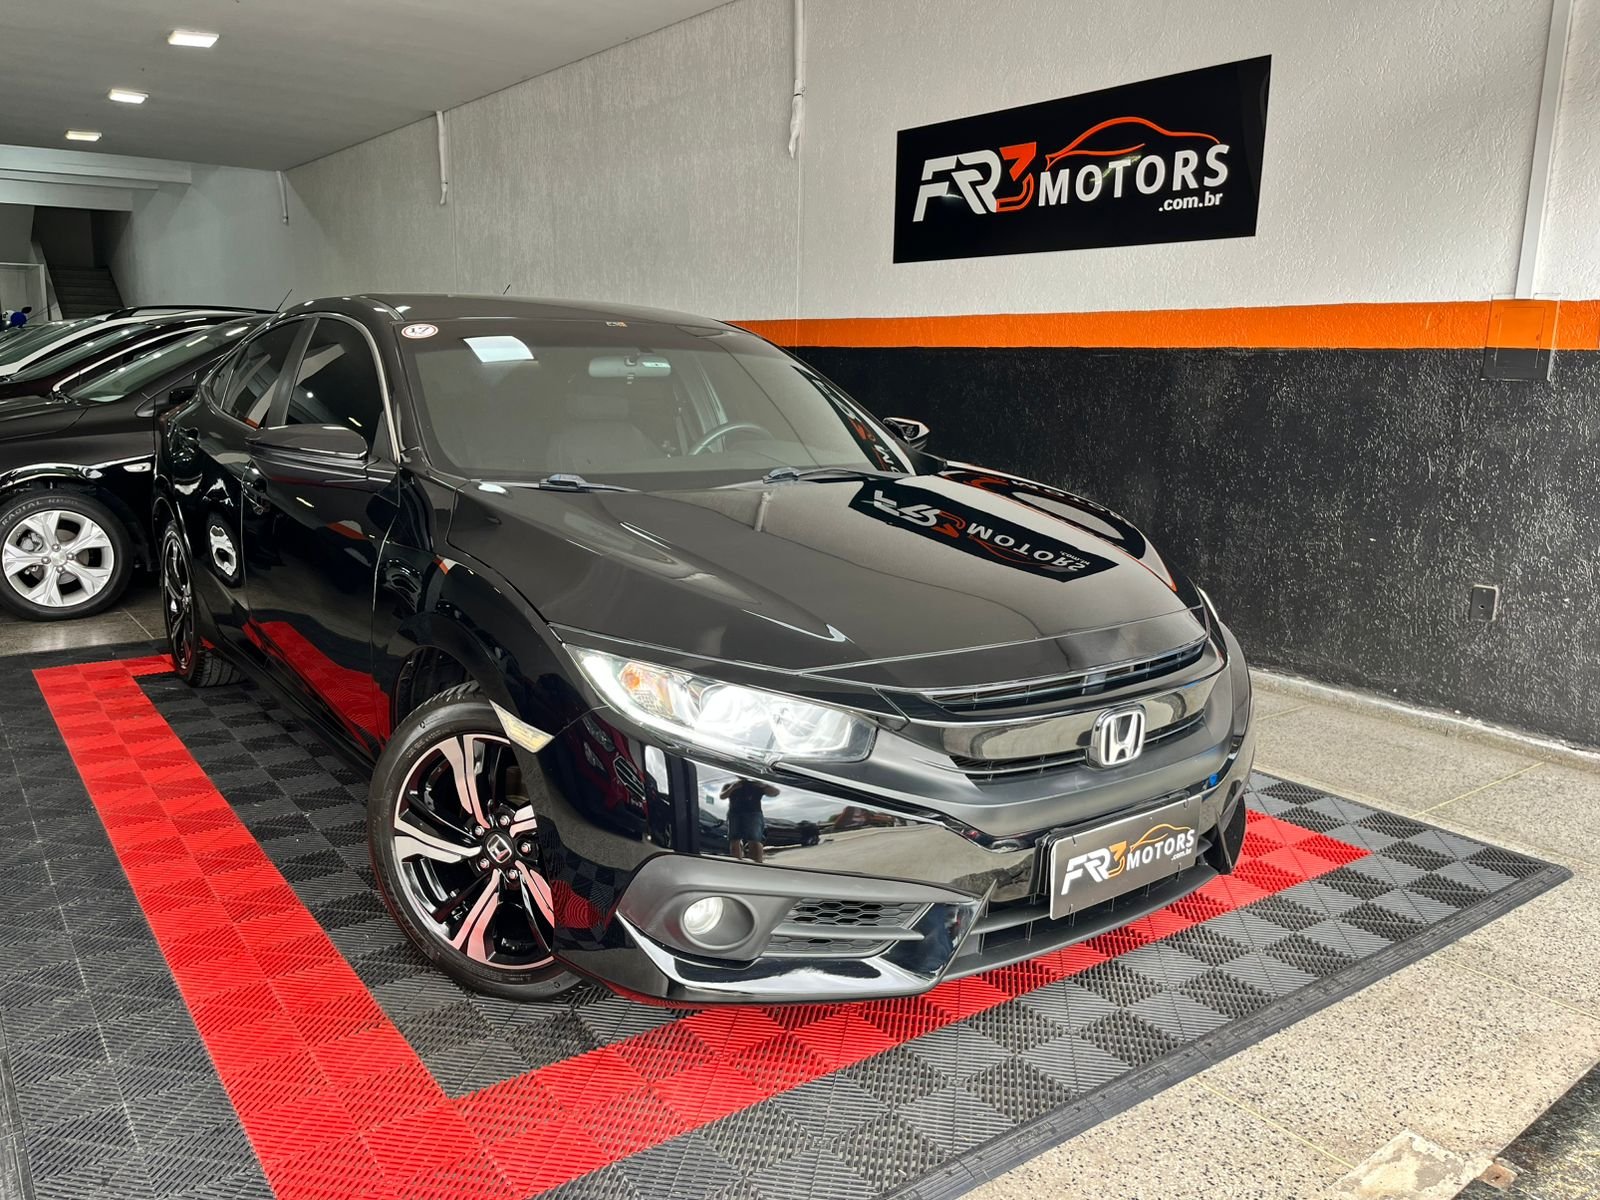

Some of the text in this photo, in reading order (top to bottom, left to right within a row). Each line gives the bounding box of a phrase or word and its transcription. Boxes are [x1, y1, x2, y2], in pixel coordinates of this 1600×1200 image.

[1038, 144, 1229, 206] MOTORS
[1158, 191, 1223, 212] .com.br
[1126, 829, 1195, 871] MOTORS
